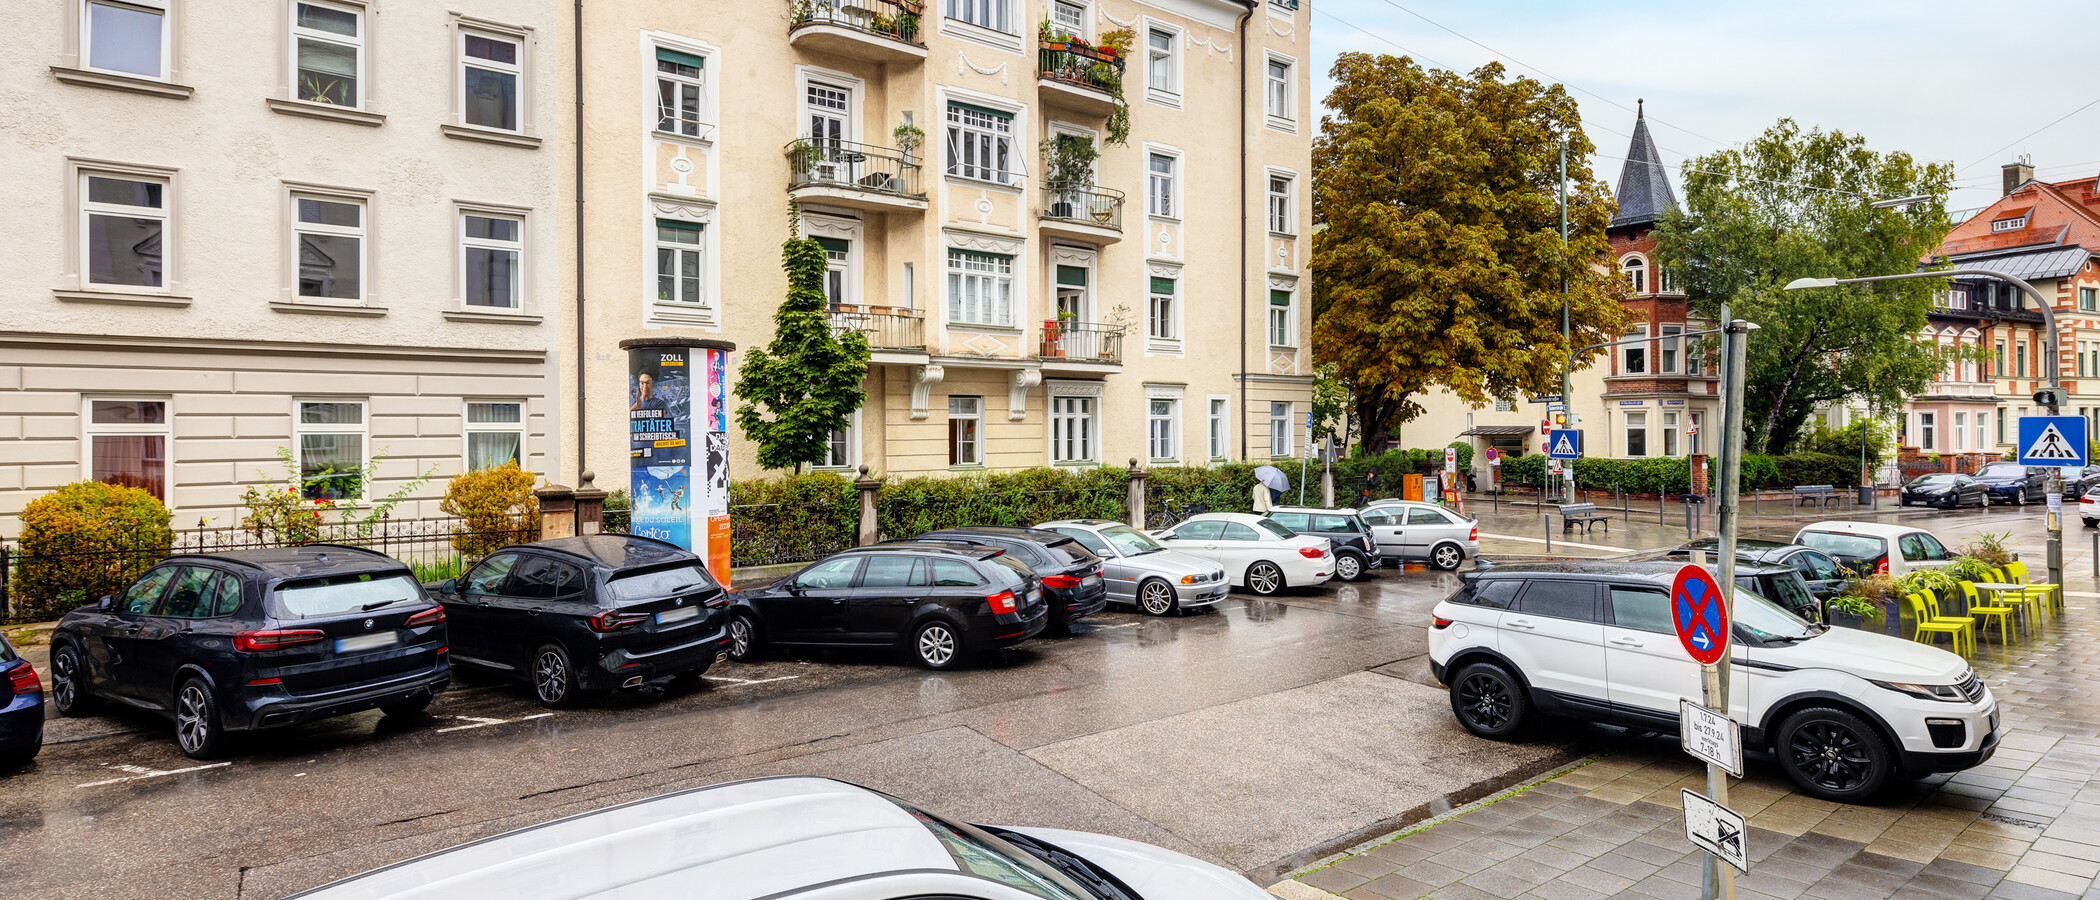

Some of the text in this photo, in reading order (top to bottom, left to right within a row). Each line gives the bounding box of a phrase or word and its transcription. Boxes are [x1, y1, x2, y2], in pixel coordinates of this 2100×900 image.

[1694, 721, 1724, 741] bis 27.9.24
[1700, 742, 1721, 760] 7-18 h
